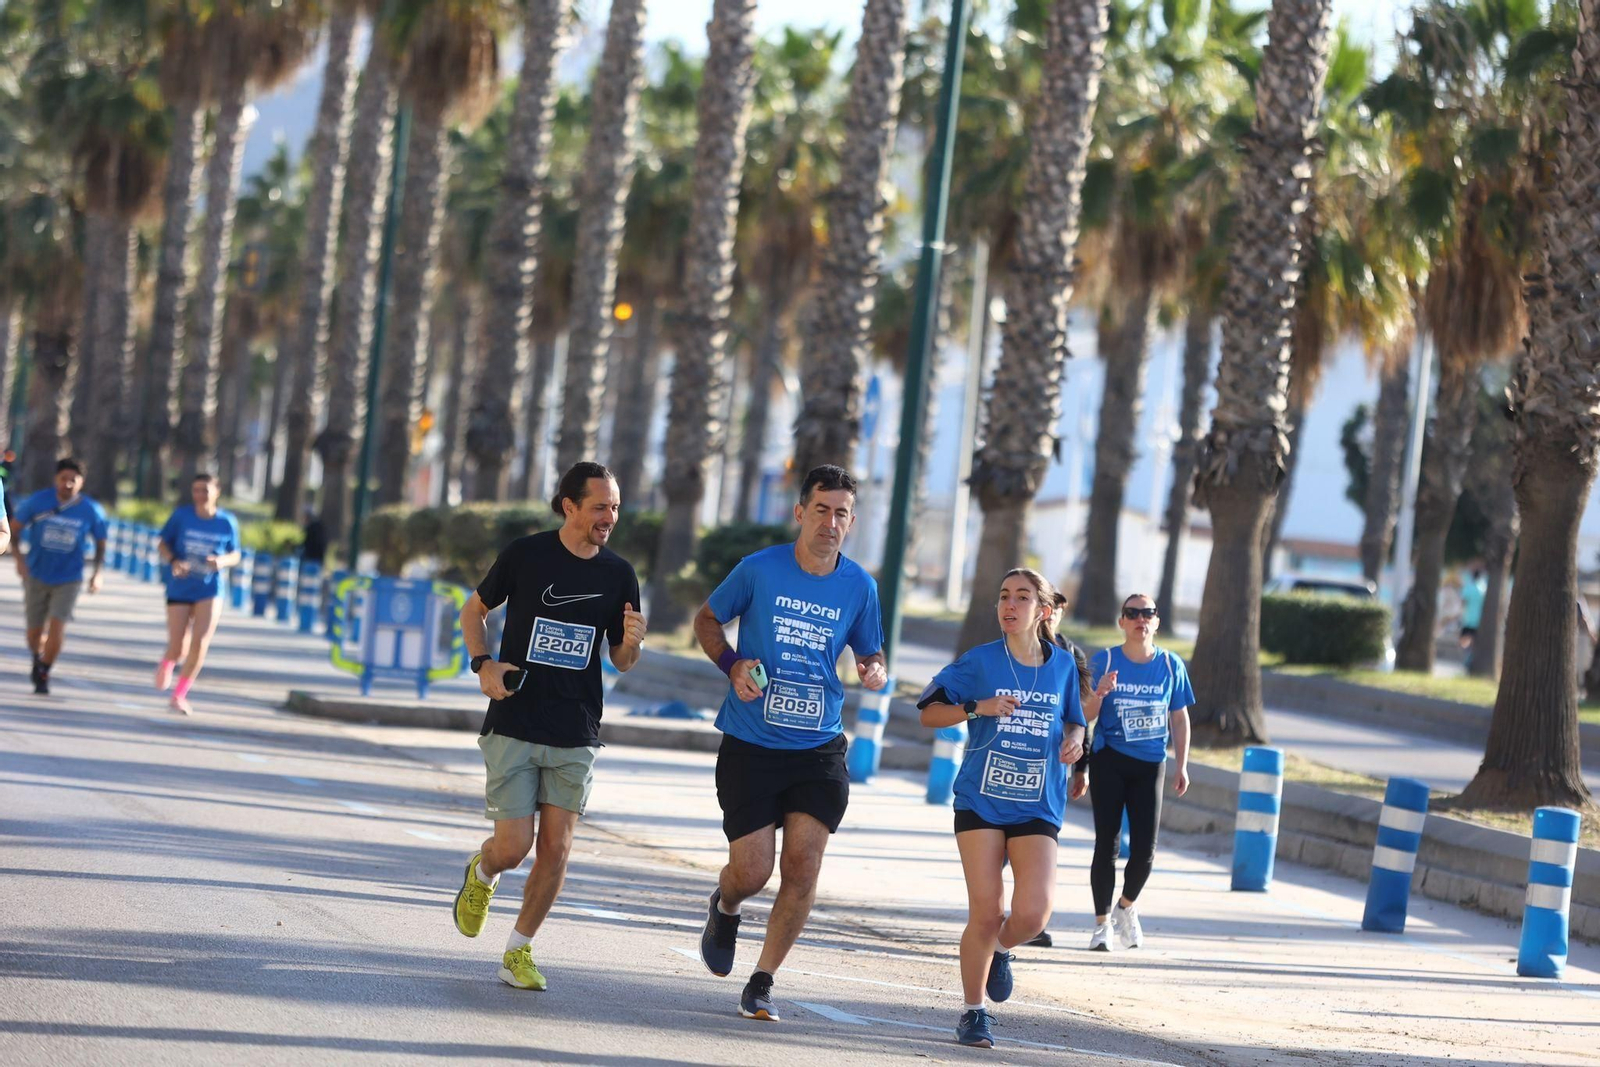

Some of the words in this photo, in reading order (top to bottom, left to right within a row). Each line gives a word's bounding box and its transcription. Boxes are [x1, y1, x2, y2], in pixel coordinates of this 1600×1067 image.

[775, 595, 841, 621] mayoral
[772, 615, 834, 638] RUNNING
[778, 625, 827, 644] MAKES
[538, 636, 585, 655] 2204
[775, 634, 826, 651] FRIENDS
[995, 688, 1060, 706] mayoral
[1115, 683, 1163, 695] mayoral
[772, 696, 818, 715] 2093
[996, 724, 1050, 738] FRIENDS
[999, 716, 1050, 729] MAKES
[1127, 716, 1162, 729] 2031
[991, 769, 1038, 787] 2094
